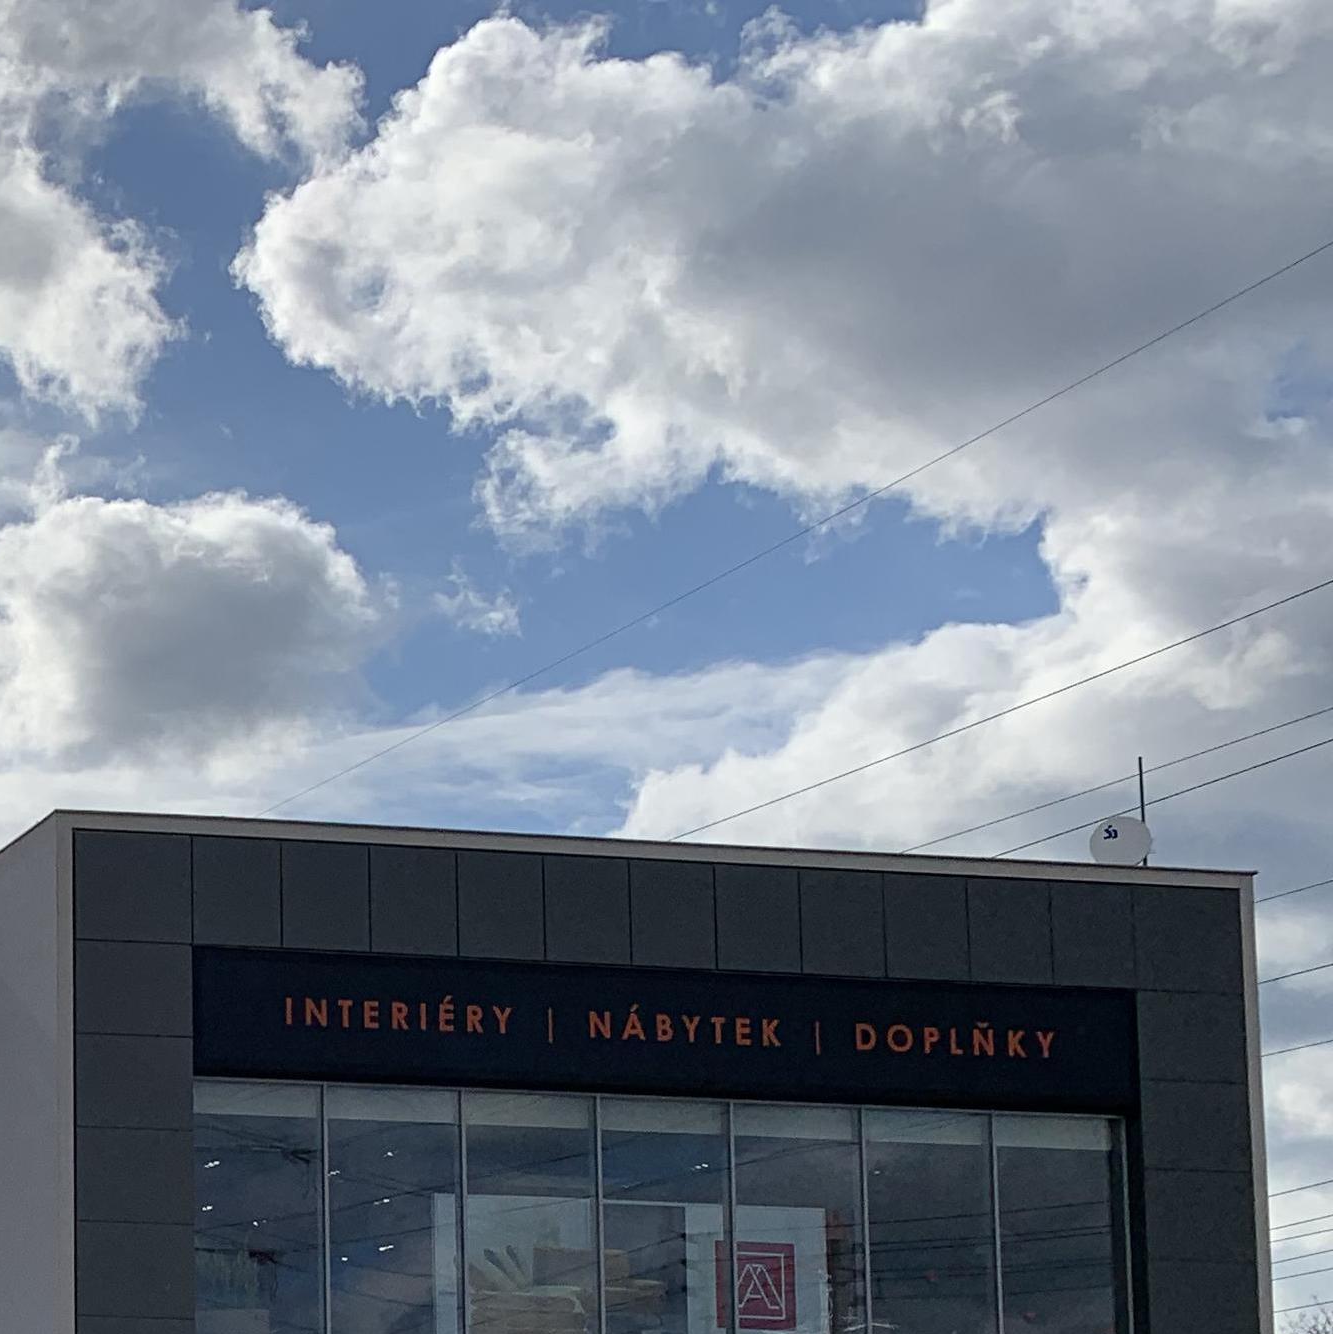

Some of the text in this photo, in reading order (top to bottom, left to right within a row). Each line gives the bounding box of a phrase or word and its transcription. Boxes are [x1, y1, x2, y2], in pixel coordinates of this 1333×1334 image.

[284, 996, 514, 1034] INTERIÉRY
[588, 1004, 782, 1048] NÁBYTEK
[854, 1021, 1056, 1059] DOPLŇKY
